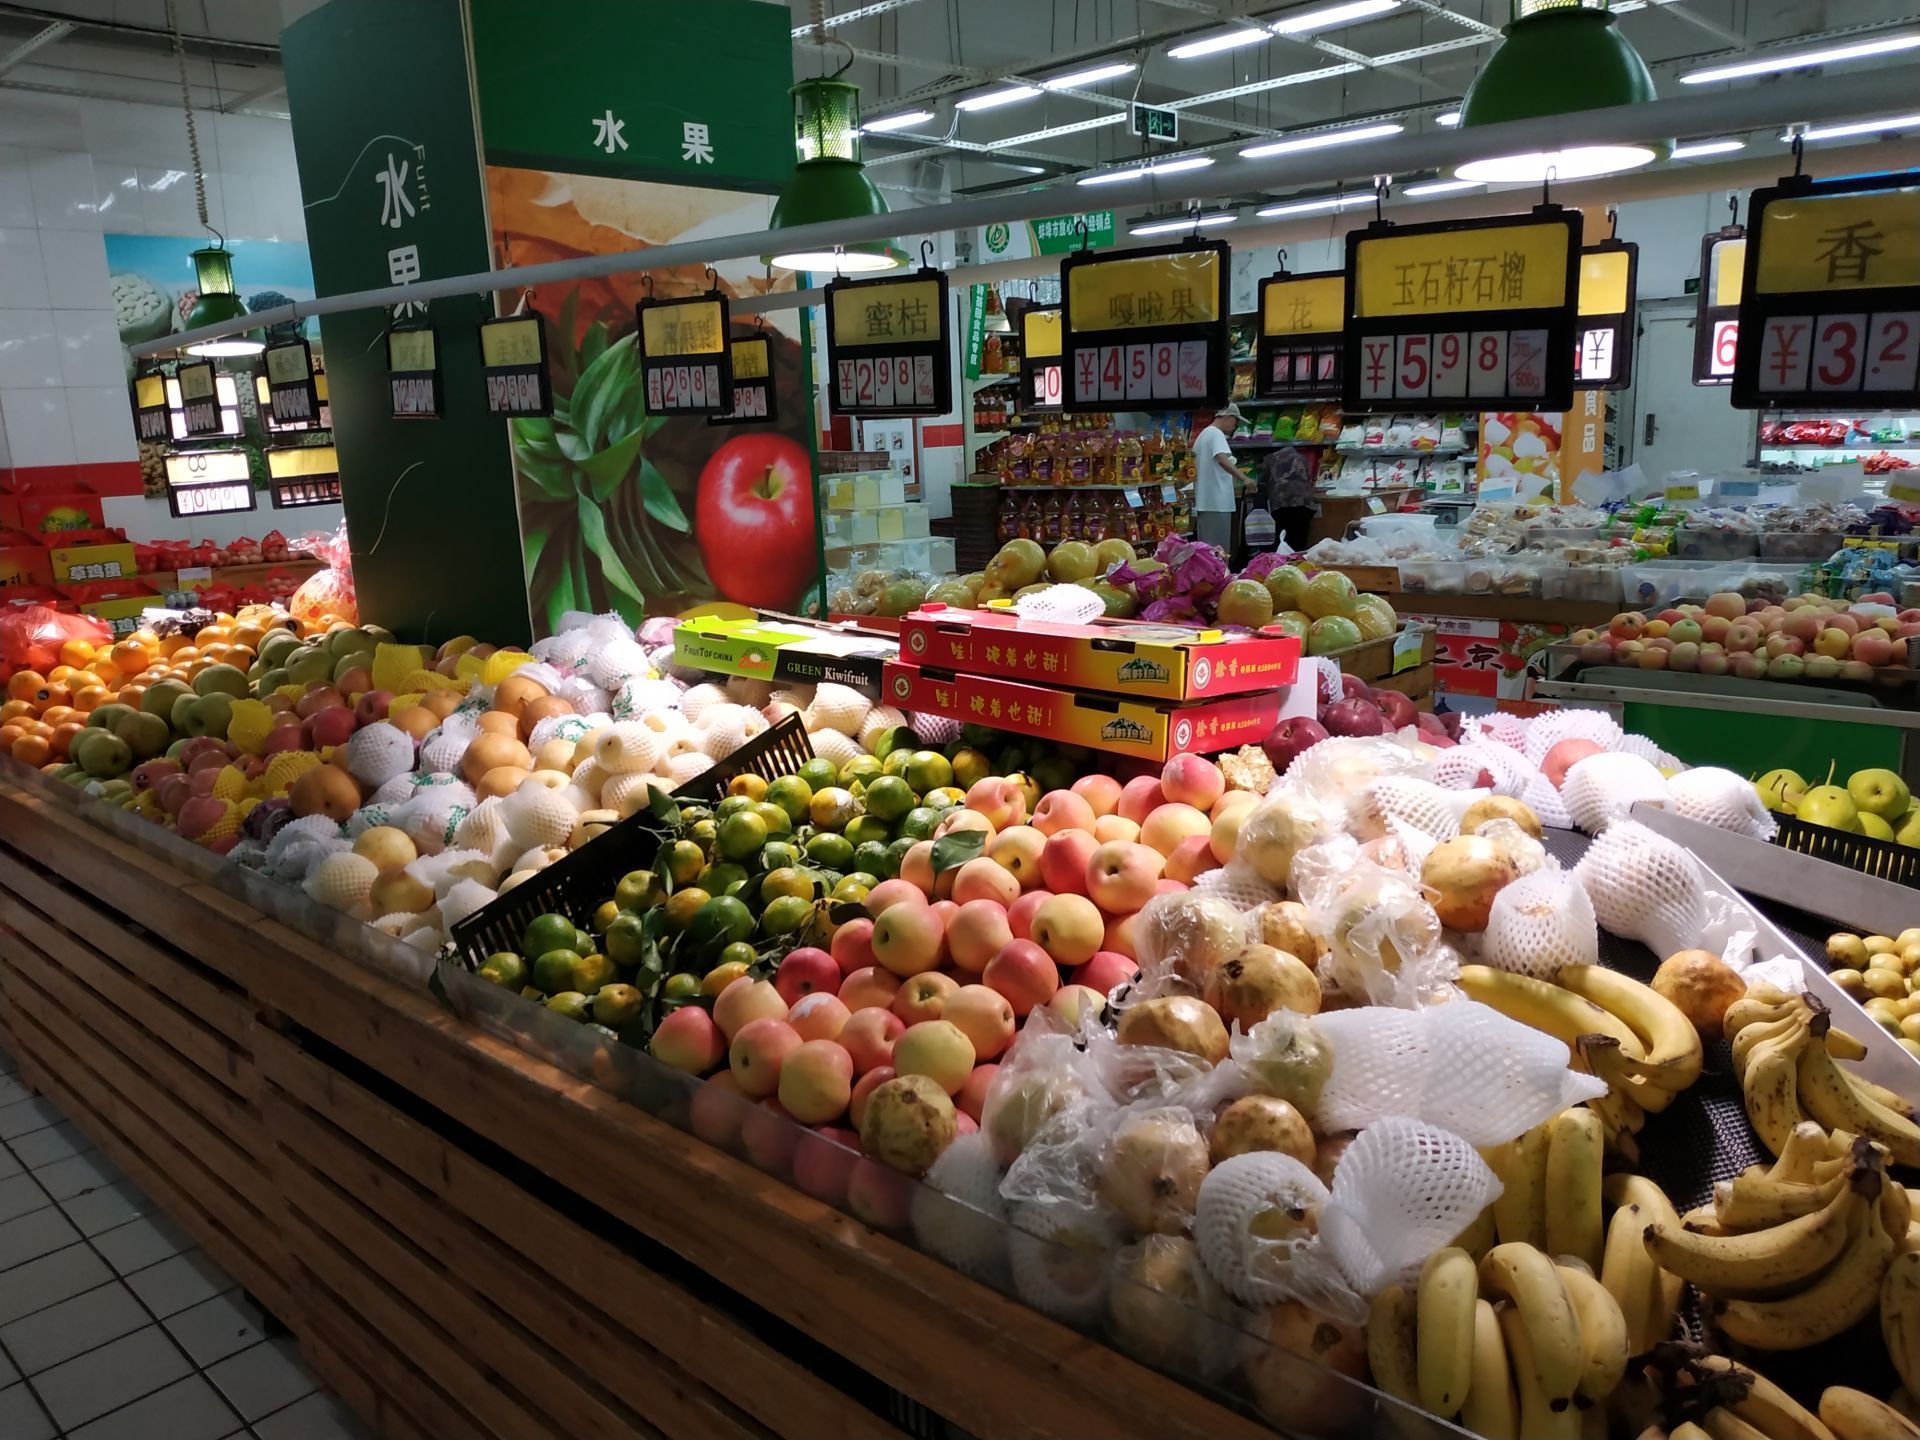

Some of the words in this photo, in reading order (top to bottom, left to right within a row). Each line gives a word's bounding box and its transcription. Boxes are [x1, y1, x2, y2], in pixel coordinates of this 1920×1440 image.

[413, 144, 431, 212] Furit
[1814, 219, 1884, 283] 香
[1392, 251, 1525, 306] 玉石籽石榴
[865, 298, 928, 338] 蜜桔
[1108, 287, 1196, 327] 嘎啦果
[787, 662, 822, 676] GREEN
[824, 667, 869, 686] Kiwifruit
